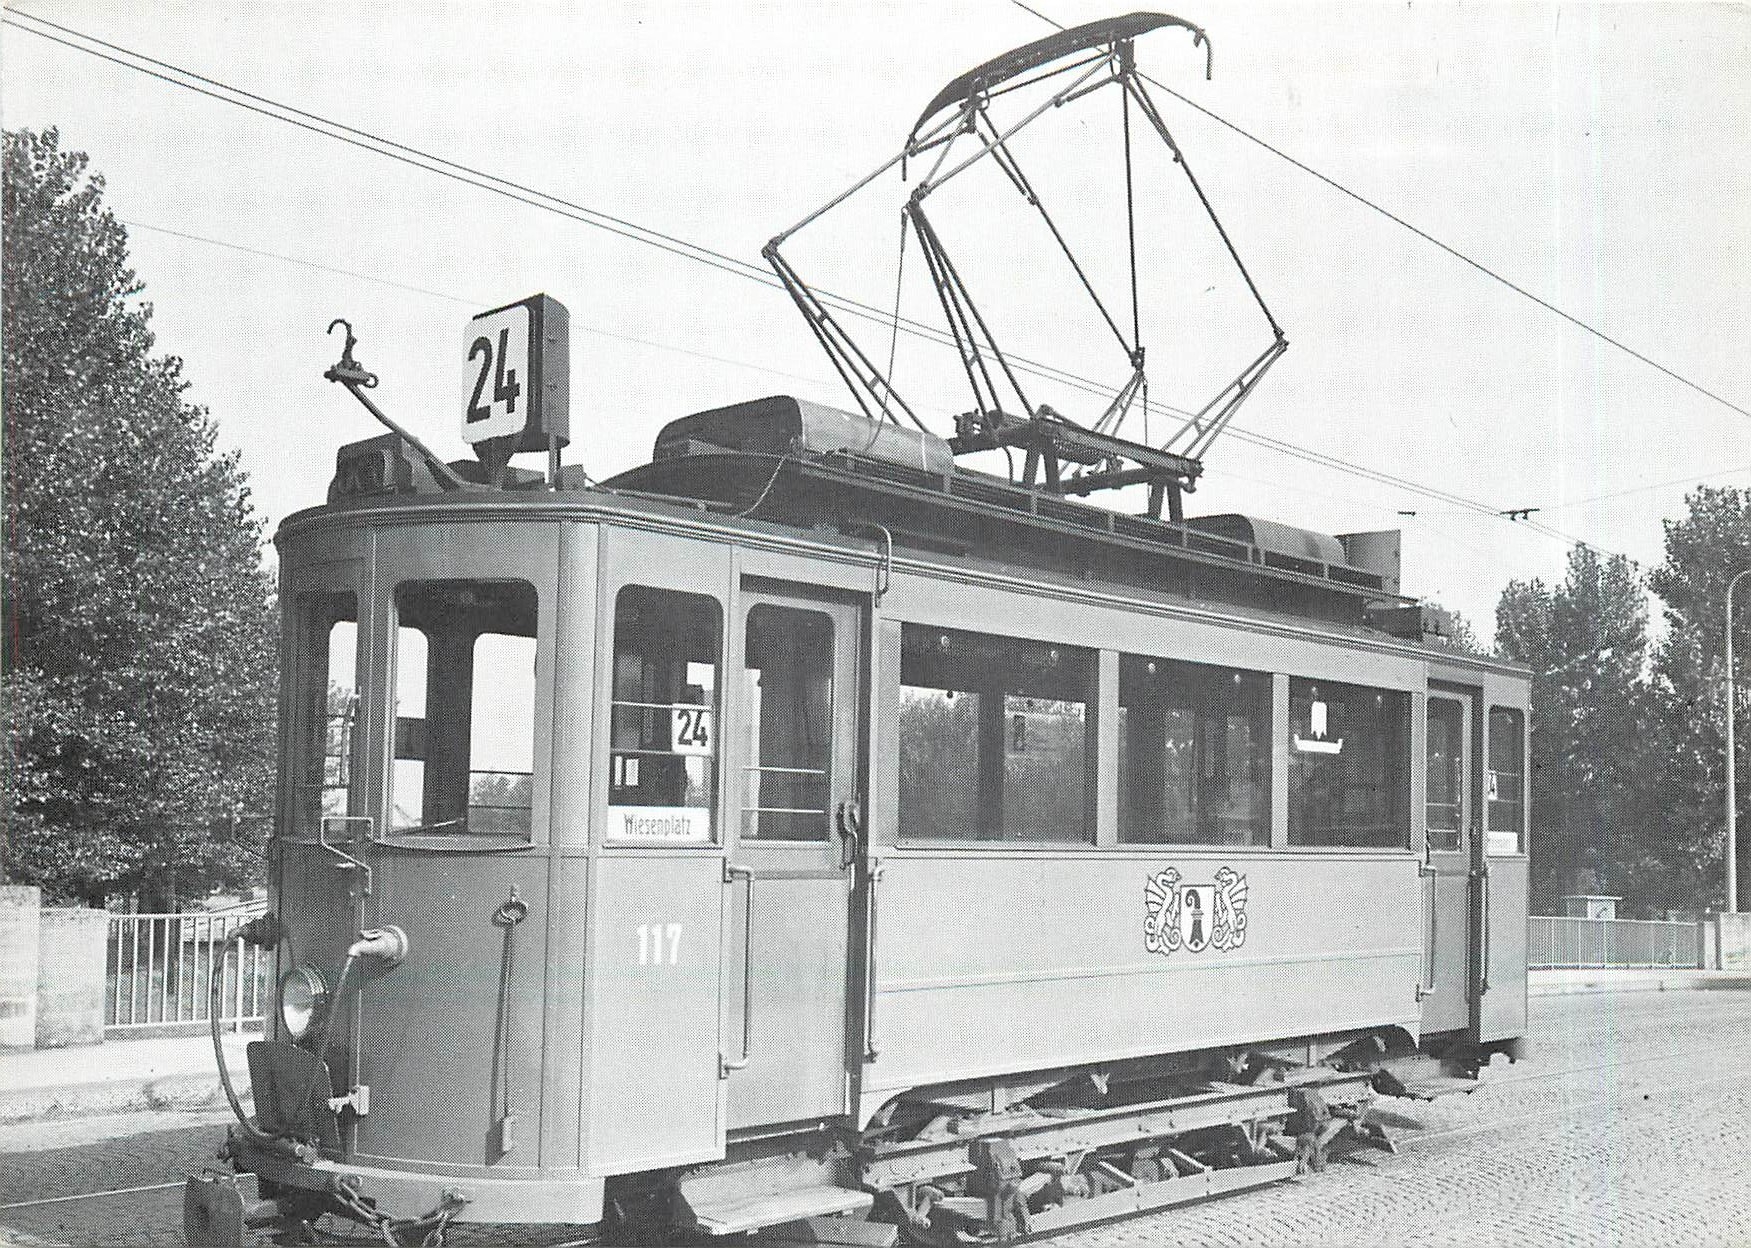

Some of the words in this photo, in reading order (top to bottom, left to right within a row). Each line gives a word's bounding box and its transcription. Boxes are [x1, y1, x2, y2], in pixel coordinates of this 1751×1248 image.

[467, 328, 520, 424] 24
[677, 708, 708, 747] 24
[624, 815, 691, 837] Wiesenplatz
[637, 923, 682, 966] 117
